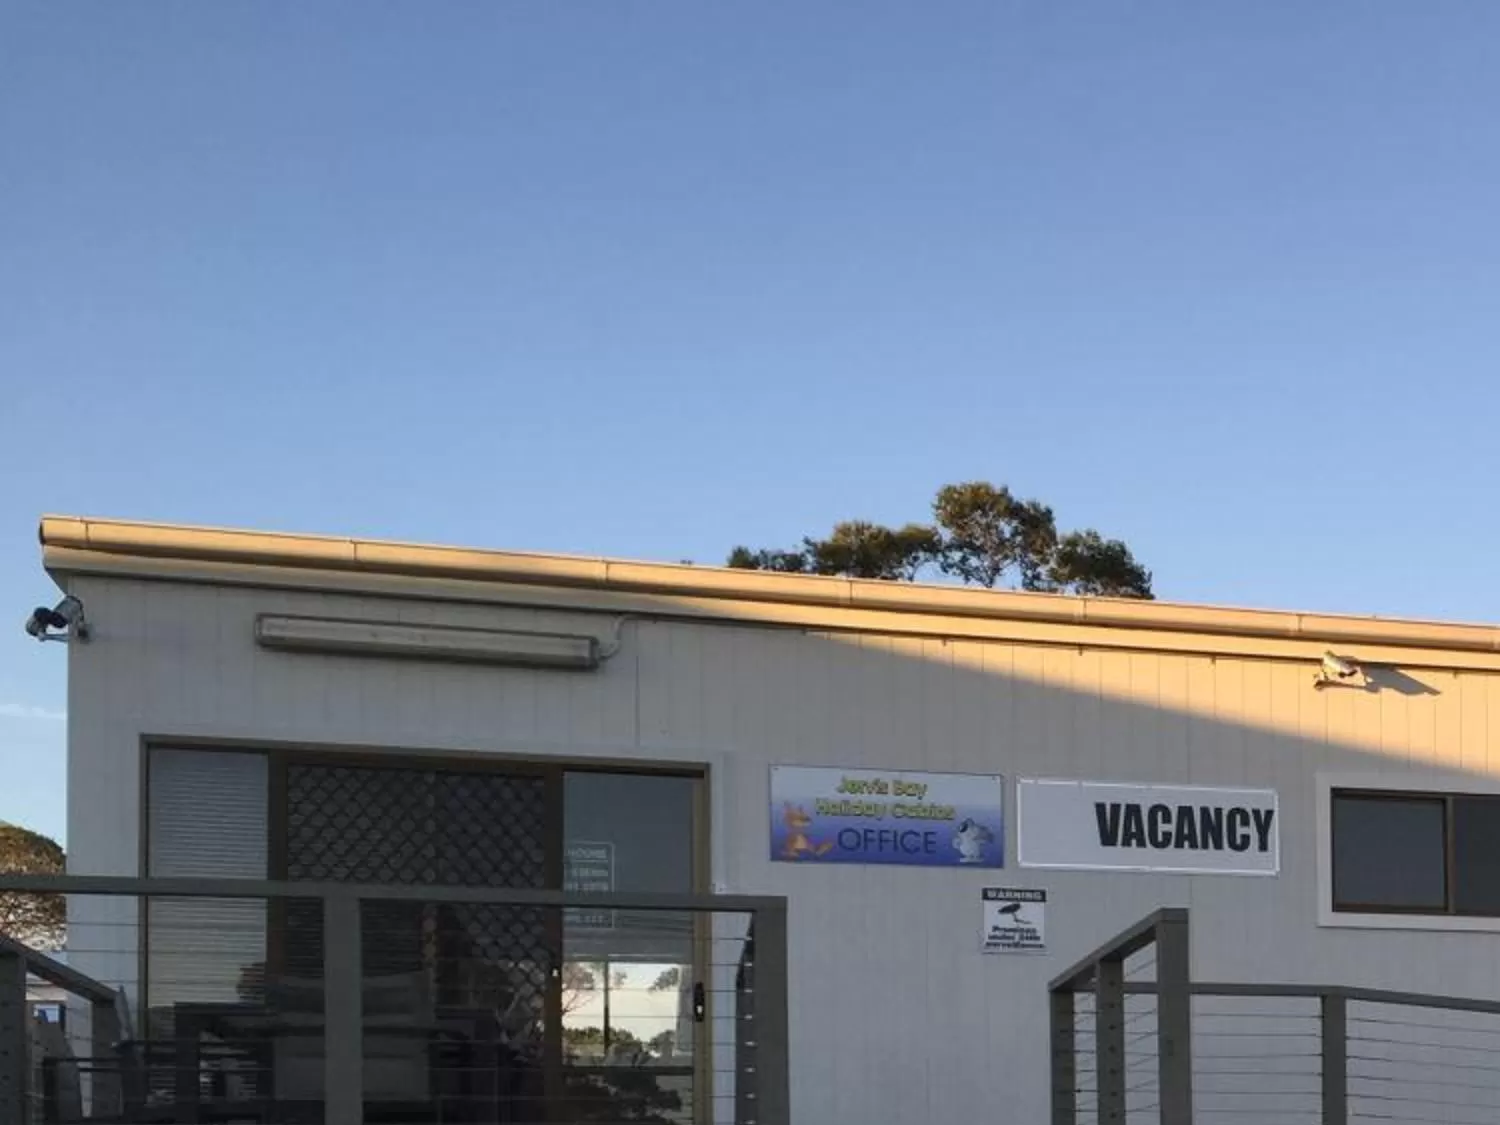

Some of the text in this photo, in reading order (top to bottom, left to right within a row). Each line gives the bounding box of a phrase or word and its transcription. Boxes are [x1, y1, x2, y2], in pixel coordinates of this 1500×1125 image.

[892, 779, 928, 800] Bay
[1095, 802, 1275, 852] VACANCY
[838, 827, 937, 854] OFFICE
[987, 890, 1042, 900] WARNING
